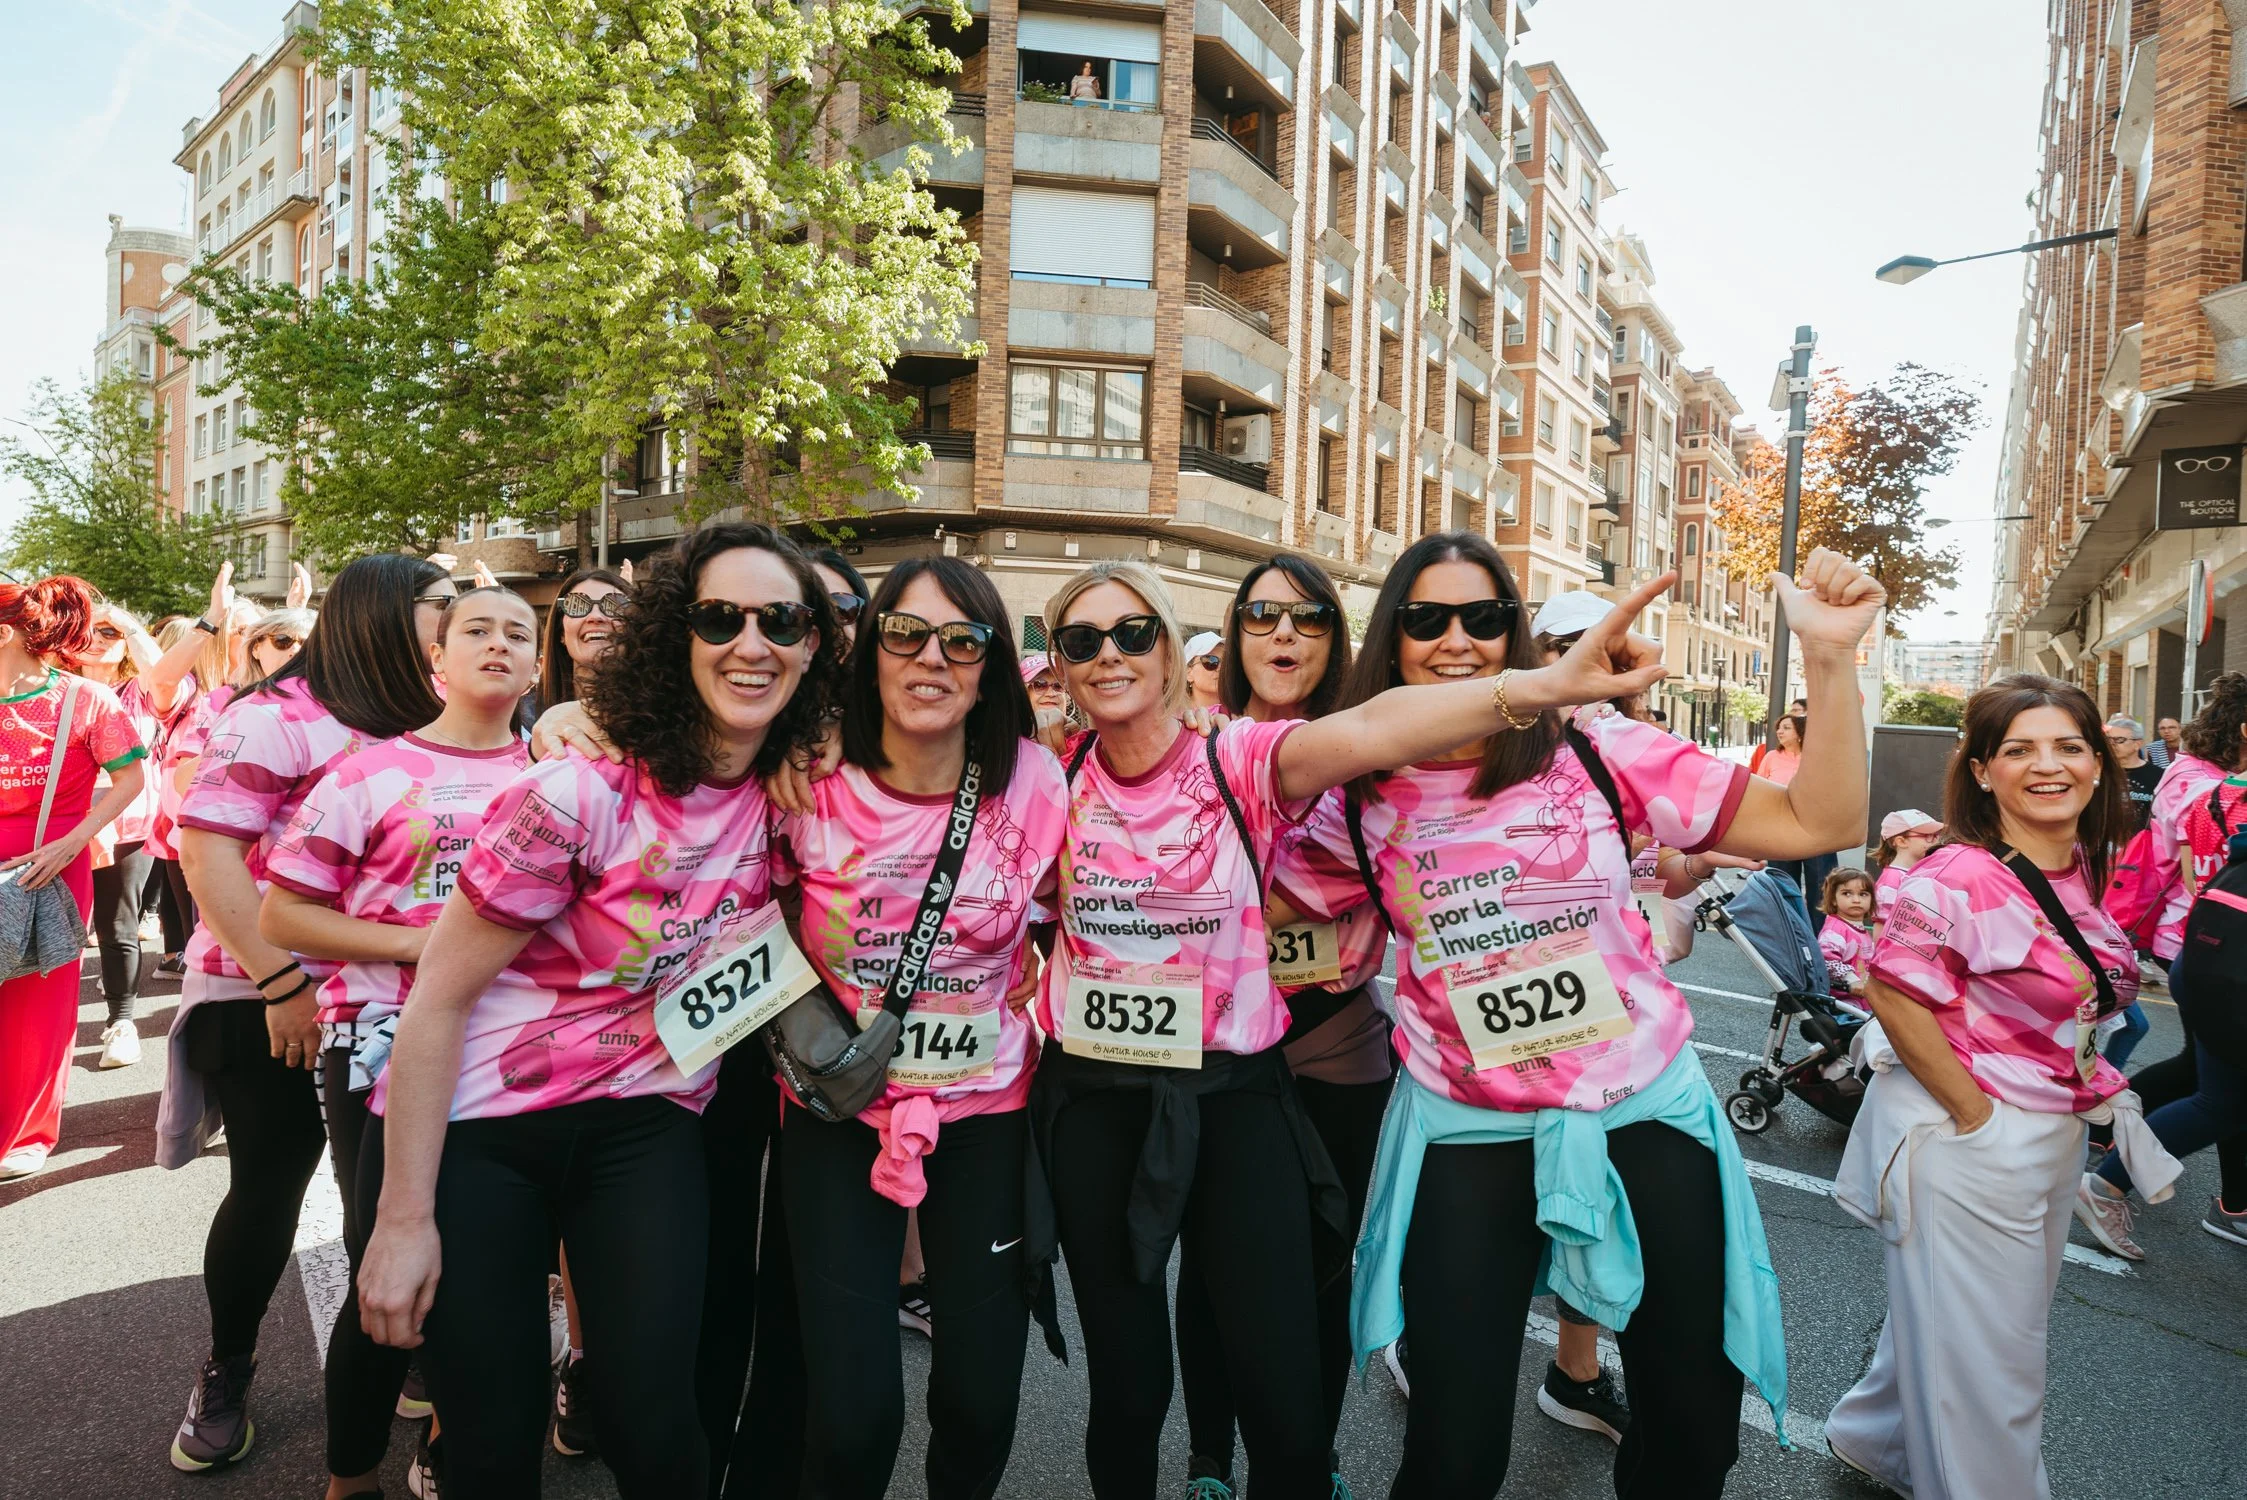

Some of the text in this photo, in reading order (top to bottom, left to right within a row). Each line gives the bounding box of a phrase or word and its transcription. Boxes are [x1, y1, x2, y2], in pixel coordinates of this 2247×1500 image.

[2190, 506, 2235, 515] BOUTIQUE
[2199, 499, 2236, 507] OPTICAL
[949, 761, 982, 850] adidas
[433, 814, 455, 830] XI
[1076, 841, 1100, 860] XI
[1414, 850, 1438, 874] XI
[878, 870, 888, 878] La
[889, 871, 908, 879] Rioja
[1073, 865, 1154, 888] Carrera
[1419, 864, 1519, 900] Carrera
[856, 897, 882, 919] XI
[1073, 895, 1135, 914] por la
[1078, 916, 1221, 940] Investigación
[1428, 898, 1502, 935] por la
[611, 888, 661, 986] mujer
[1439, 906, 1599, 957] Investigación
[896, 908, 941, 999] adidas
[852, 958, 896, 974] por
[680, 942, 772, 1031] 8527
[1084, 989, 1177, 1036] 8532
[1477, 971, 1586, 1034] 8529
[726, 1016, 753, 1040] NATUR
[754, 998, 779, 1020] HOUSE
[1103, 1046, 1130, 1056] NATUR
[1132, 1049, 1160, 1059] HOUSE
[1523, 1031, 1585, 1053] NATUR HOUSE
[900, 1071, 958, 1081] NATUR HOUSE
